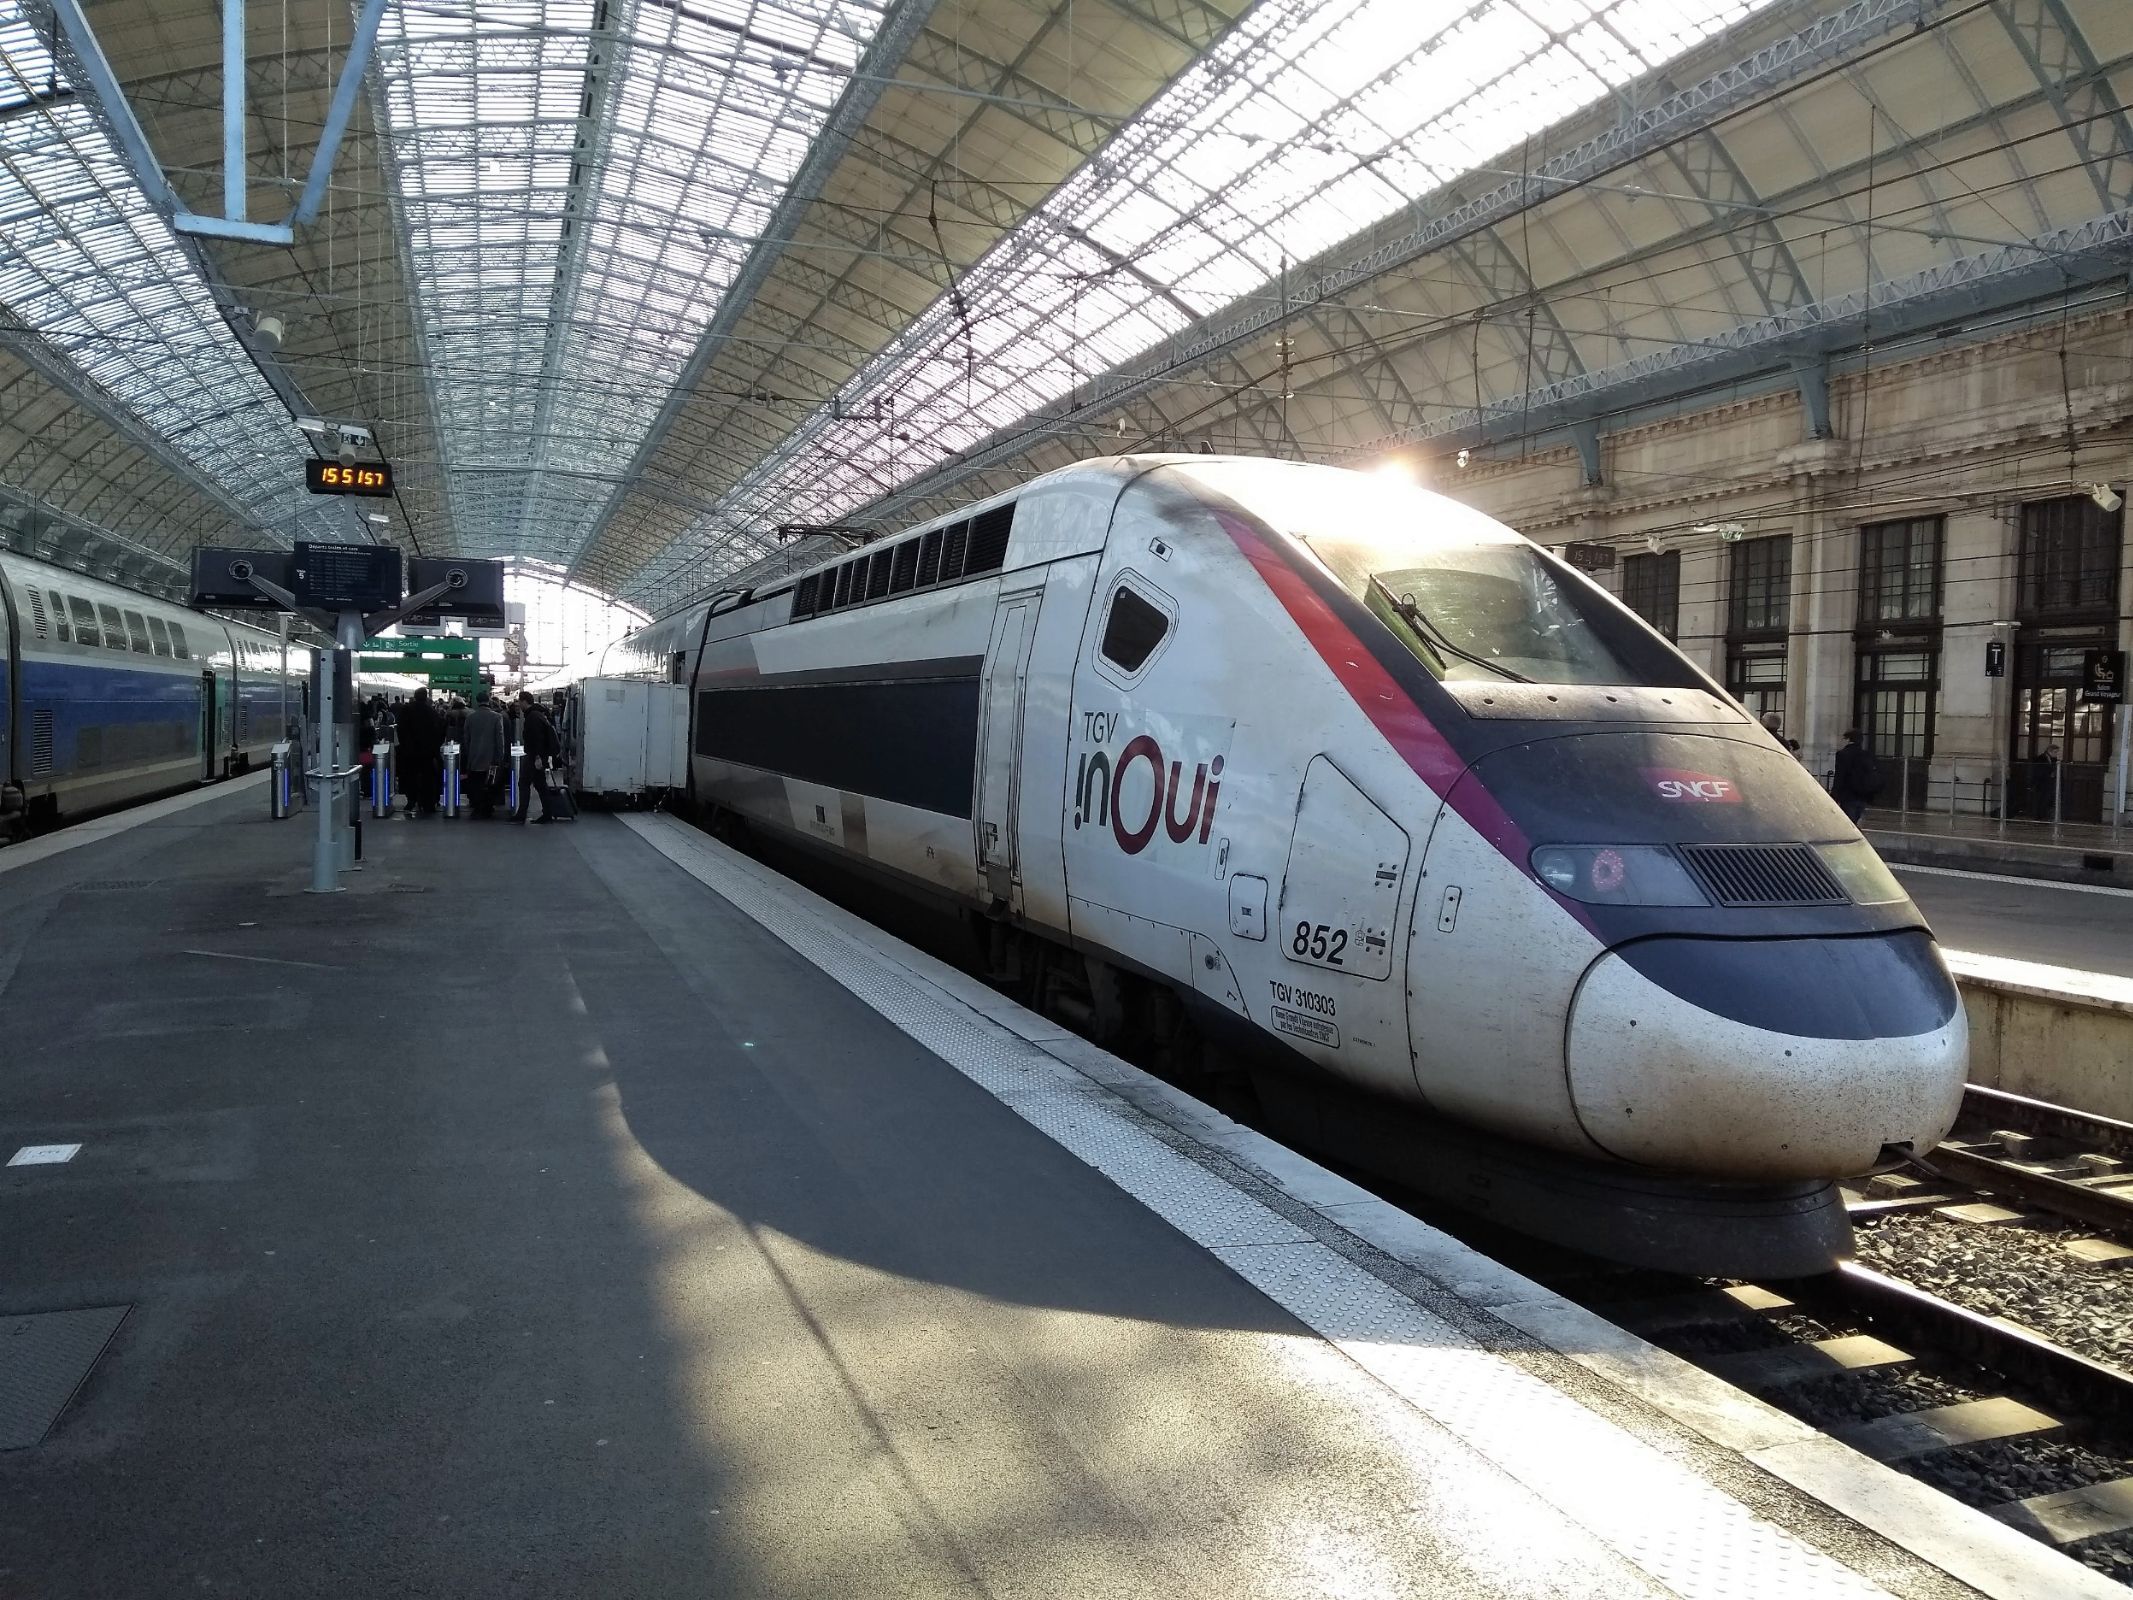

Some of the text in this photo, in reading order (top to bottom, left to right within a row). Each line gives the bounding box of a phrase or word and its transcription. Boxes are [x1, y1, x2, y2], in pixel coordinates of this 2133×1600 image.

[298, 572, 304, 580] 5
[398, 640, 419, 648] Sortie
[1992, 649, 2001, 665] T
[1084, 711, 1119, 744] TGV
[1657, 780, 1730, 798] SNCF
[1292, 920, 1348, 966] 852
[1269, 980, 1335, 1016] TGV 310303
